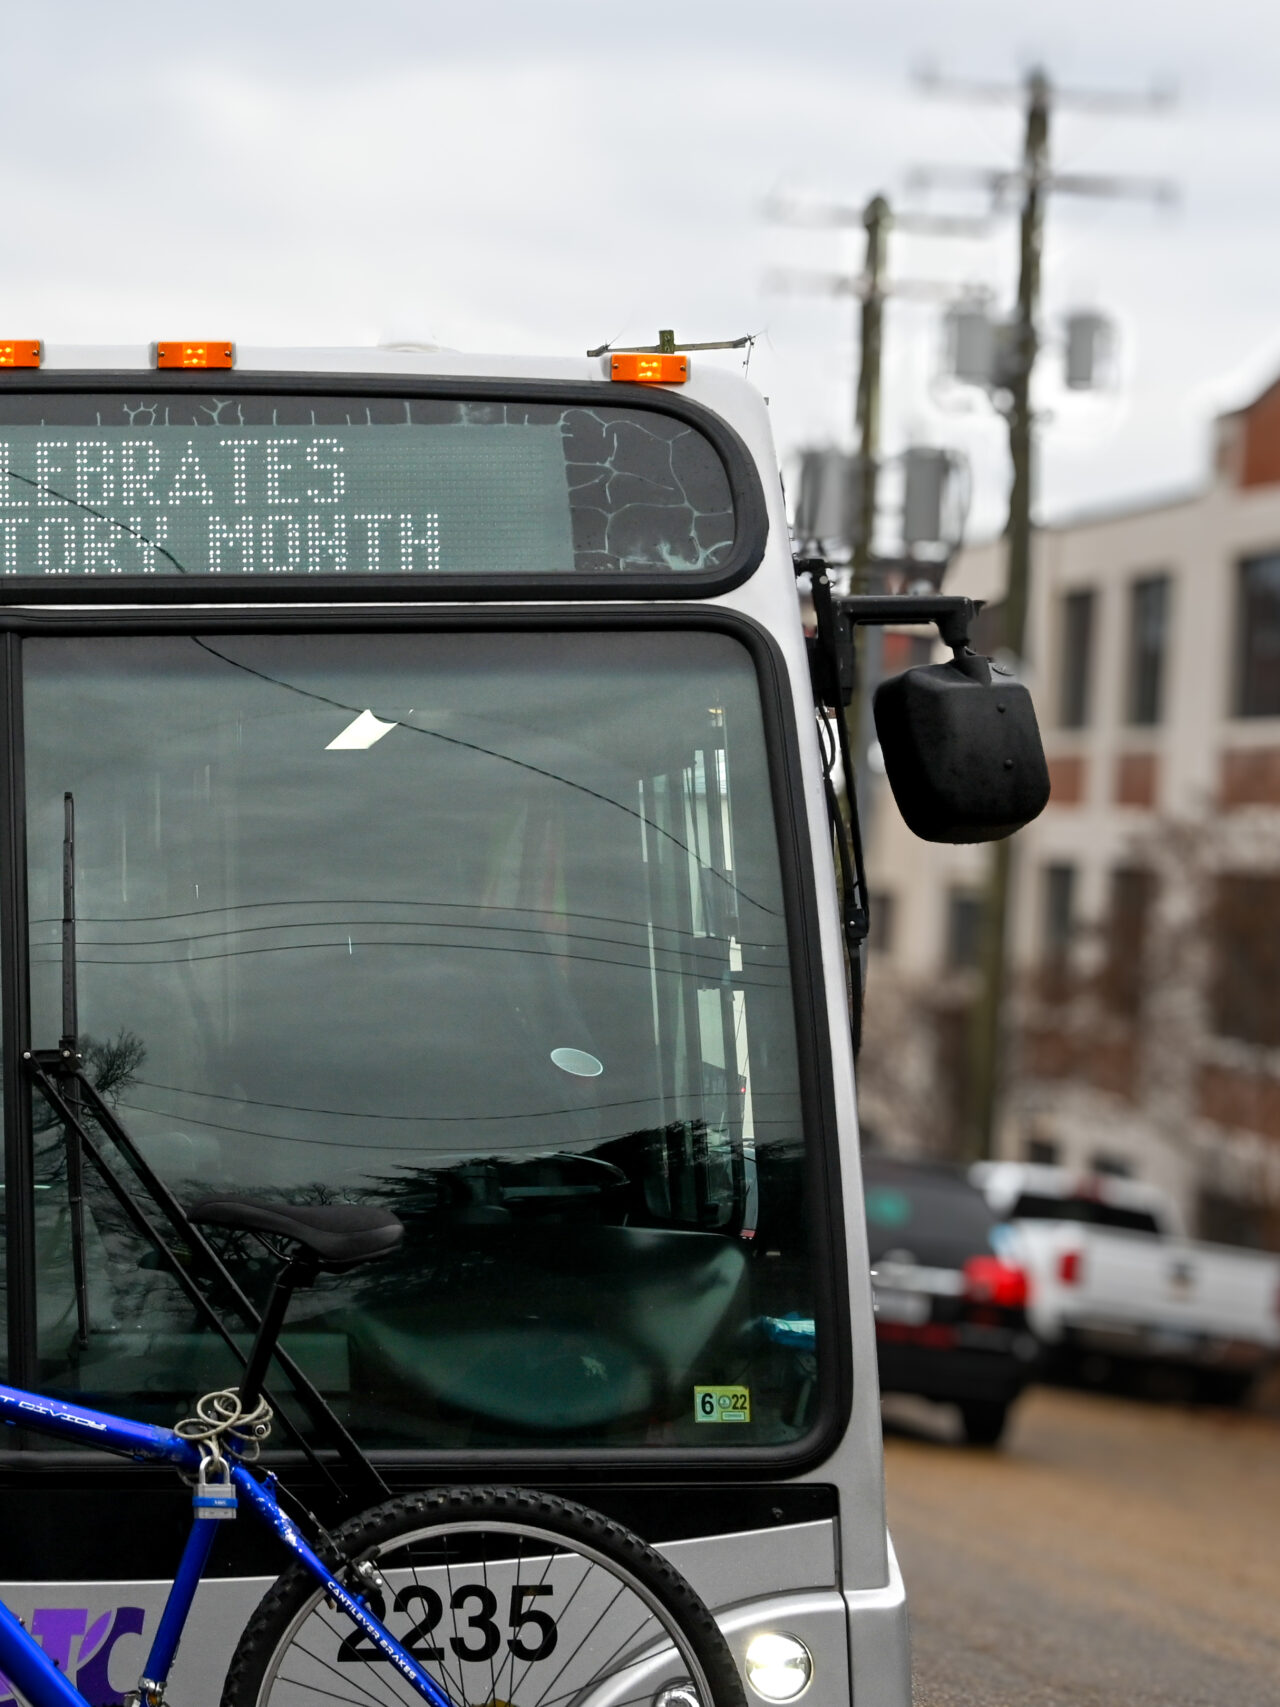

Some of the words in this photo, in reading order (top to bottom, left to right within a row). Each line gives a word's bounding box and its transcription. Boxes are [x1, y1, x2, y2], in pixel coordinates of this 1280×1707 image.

[208, 513, 439, 574] MONTH
[701, 1392, 715, 1415] 6
[731, 1394, 747, 1410] 22
[327, 1581, 380, 1640] CANTILEVER
[379, 1639, 417, 1680] BRAKES
[337, 1584, 558, 1662] 2235
